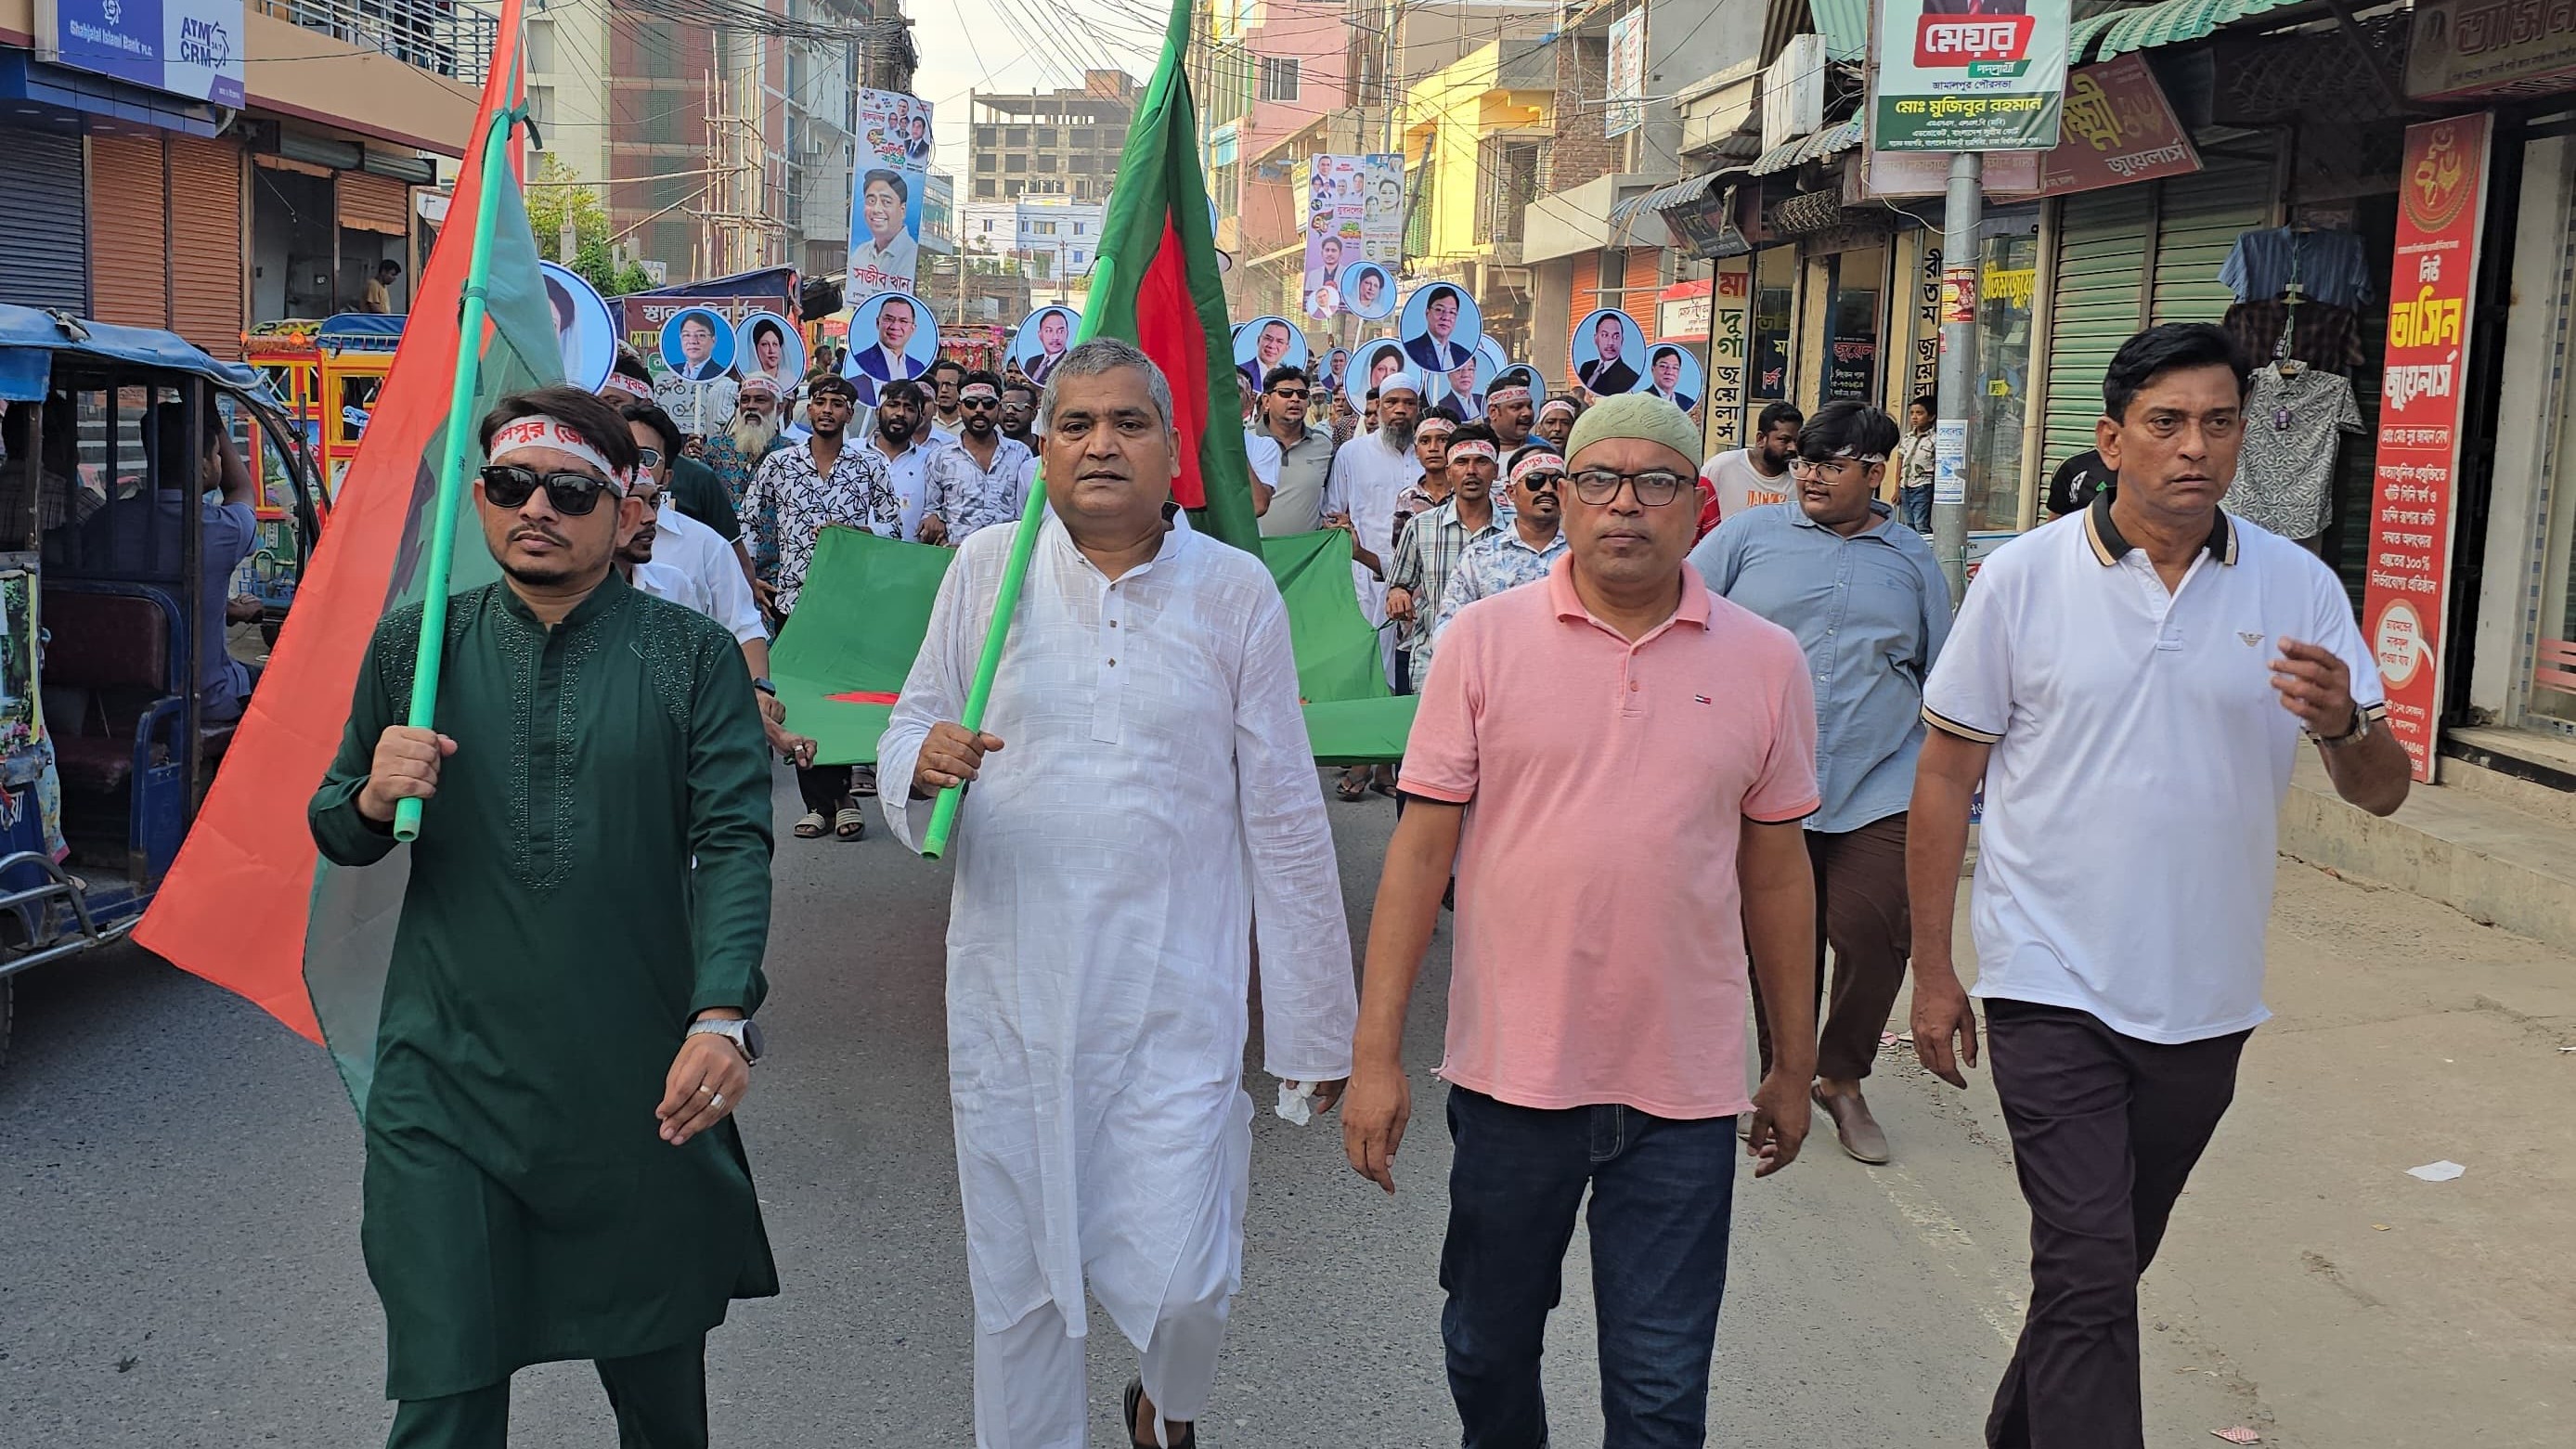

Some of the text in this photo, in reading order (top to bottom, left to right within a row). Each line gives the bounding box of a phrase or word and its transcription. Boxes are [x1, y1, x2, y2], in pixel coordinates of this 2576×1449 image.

[71, 19, 102, 44] Shahjalal
[102, 28, 123, 49] Islami
[123, 33, 141, 54] Bank
[181, 17, 212, 46] ATM
[1925, 22, 2017, 58] মেয়র
[181, 41, 211, 68] CRM
[1932, 79, 2013, 93] জামালপুর পৌরসভা
[1896, 96, 2042, 118] মোঃ মুজিবুর রহমান
[2104, 138, 2187, 177] জুয়েলার্স
[852, 264, 912, 292] সজীব খান
[2418, 254, 2441, 283] নিউ
[1718, 272, 1748, 298] মা
[2389, 285, 2462, 348] তাসিন
[2384, 349, 2458, 411] জুয়েলার্স
